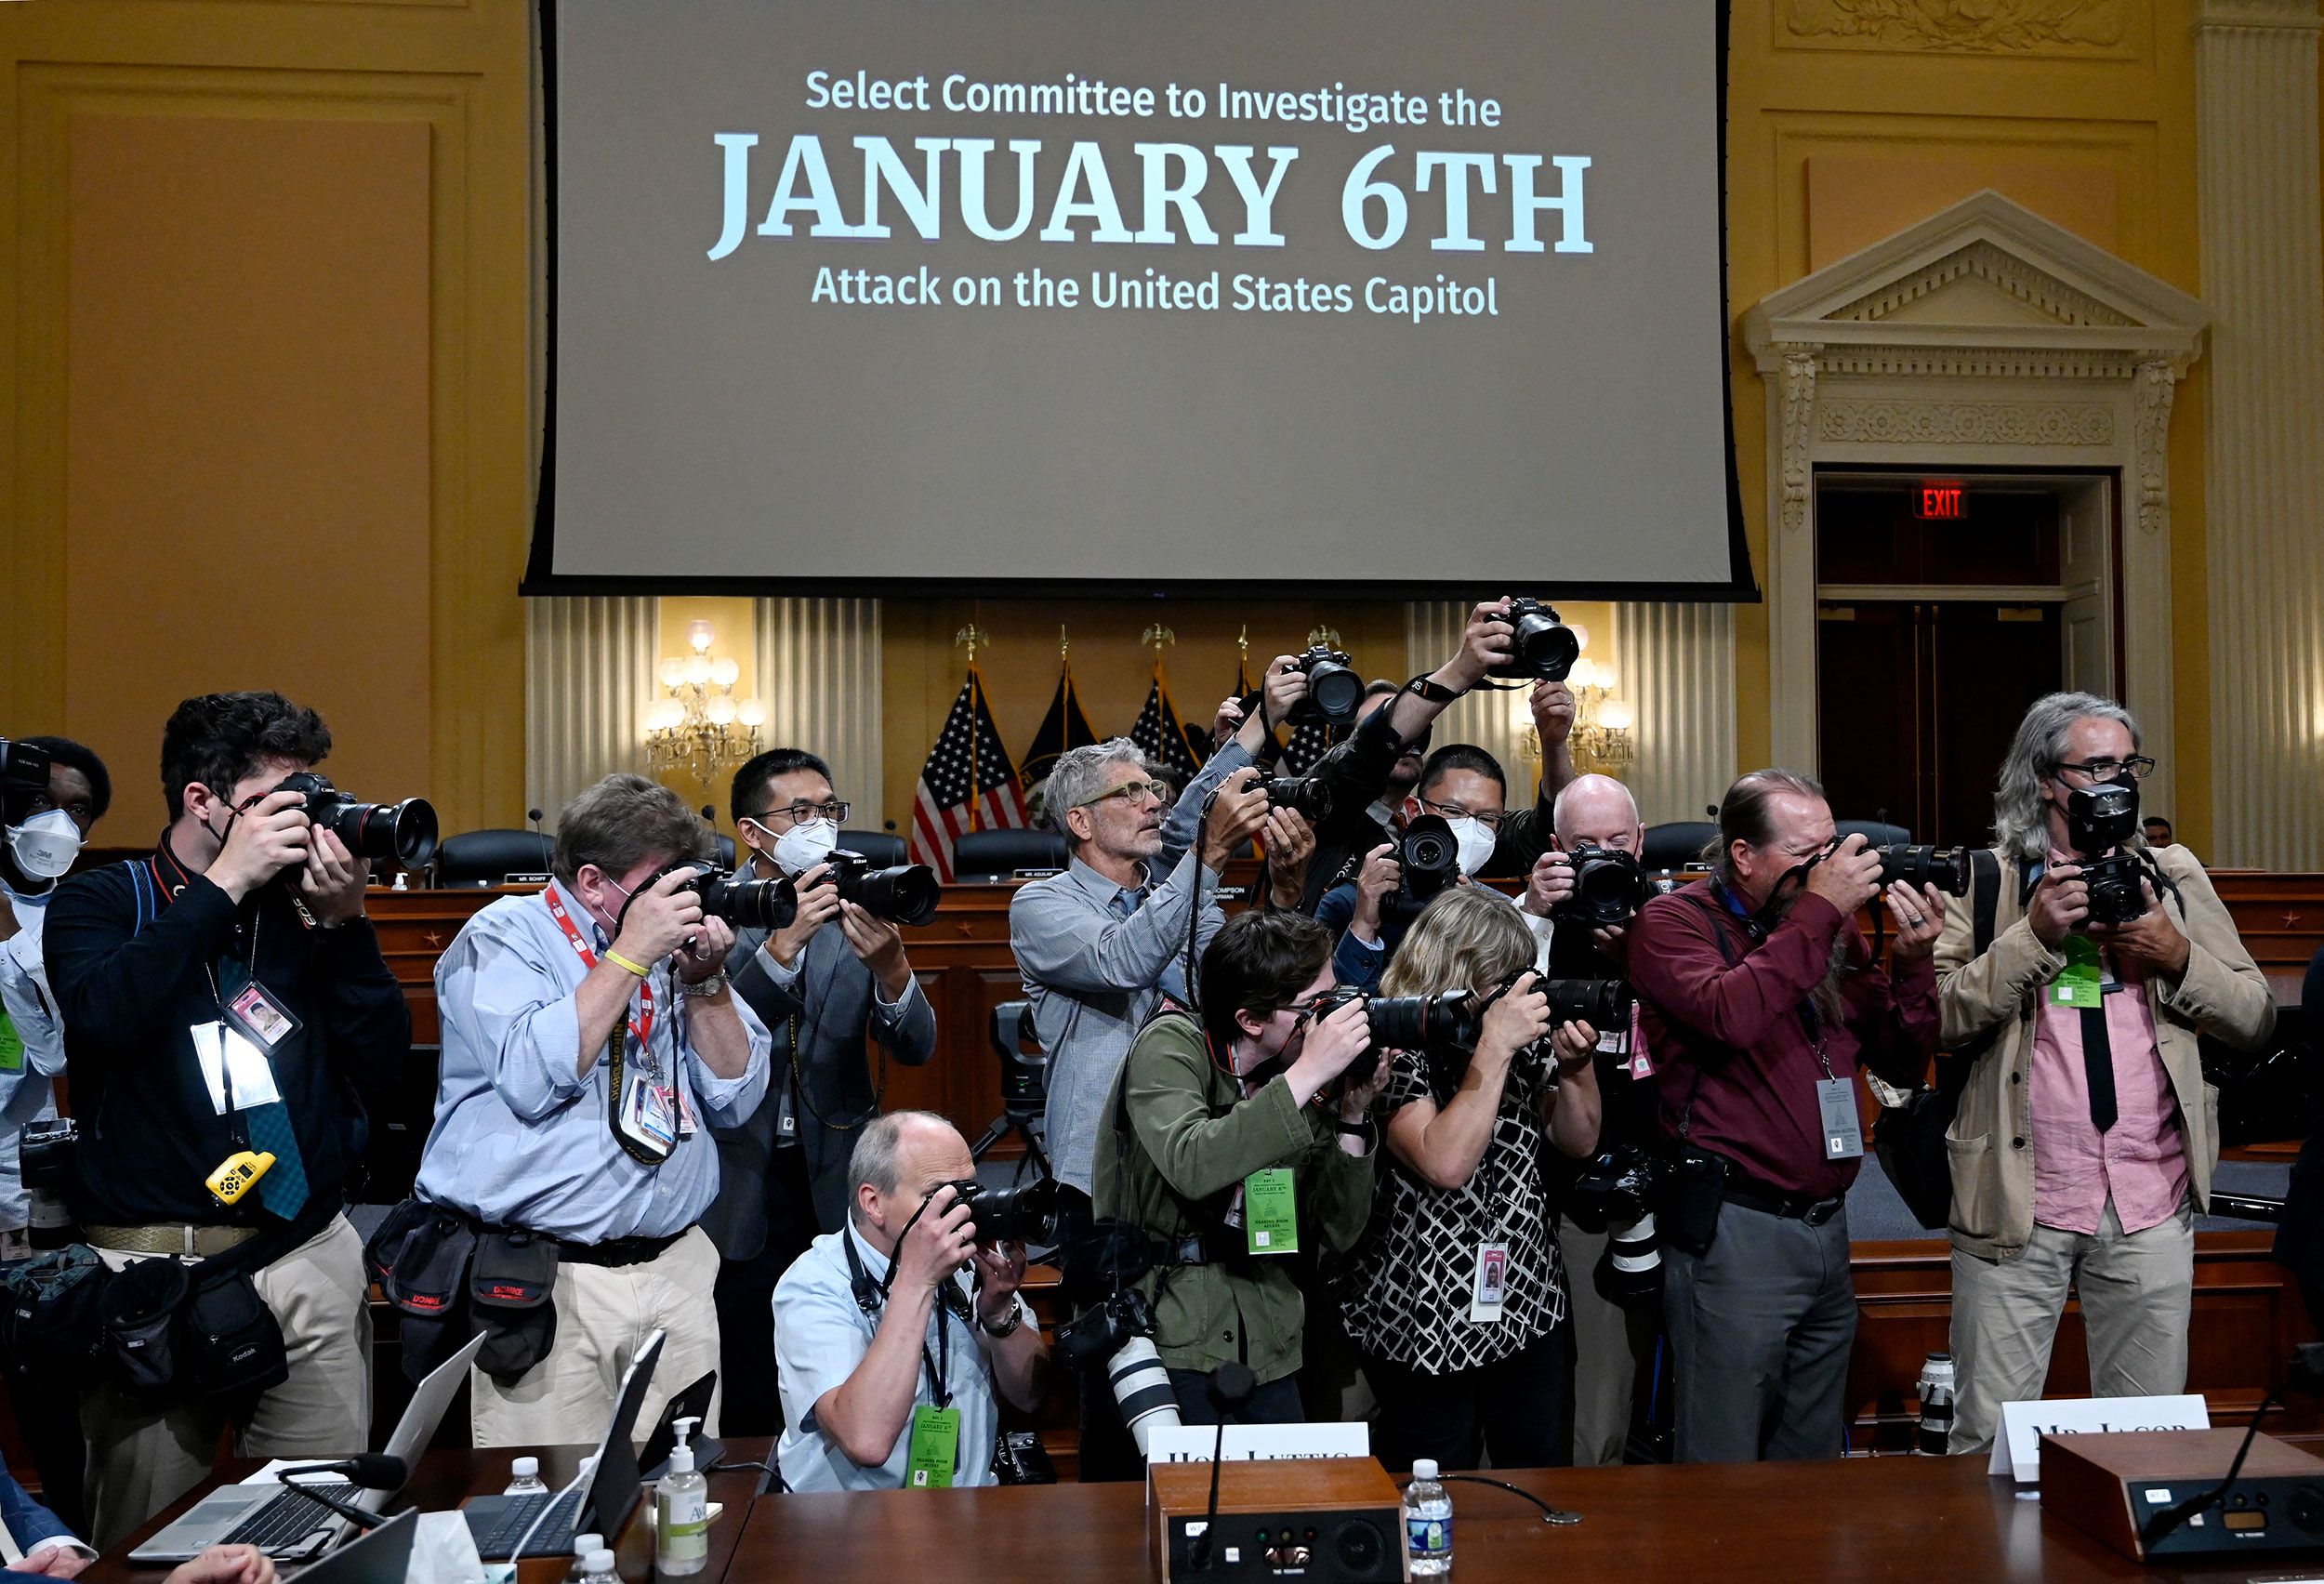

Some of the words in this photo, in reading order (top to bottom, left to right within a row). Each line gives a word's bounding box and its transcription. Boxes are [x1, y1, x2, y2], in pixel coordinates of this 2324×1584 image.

[805, 70, 931, 112] Select
[942, 73, 1155, 117] Committee
[1165, 83, 1207, 118] to
[1219, 81, 1429, 133] Investigate
[1437, 87, 1501, 127] the
[706, 133, 1300, 261] JANUARY
[1341, 143, 1594, 254] 6TH
[811, 265, 942, 306] Attack
[952, 276, 1001, 307] on
[1012, 267, 1080, 308] the
[1091, 267, 1220, 310] United
[1232, 273, 1353, 313] States
[1365, 273, 1499, 324] Capitol
[1923, 489, 1961, 517] EXIT
[413, 1294, 440, 1305] DOMKE
[494, 1286, 524, 1296] DOMKE
[232, 1347, 257, 1363] Kodak
